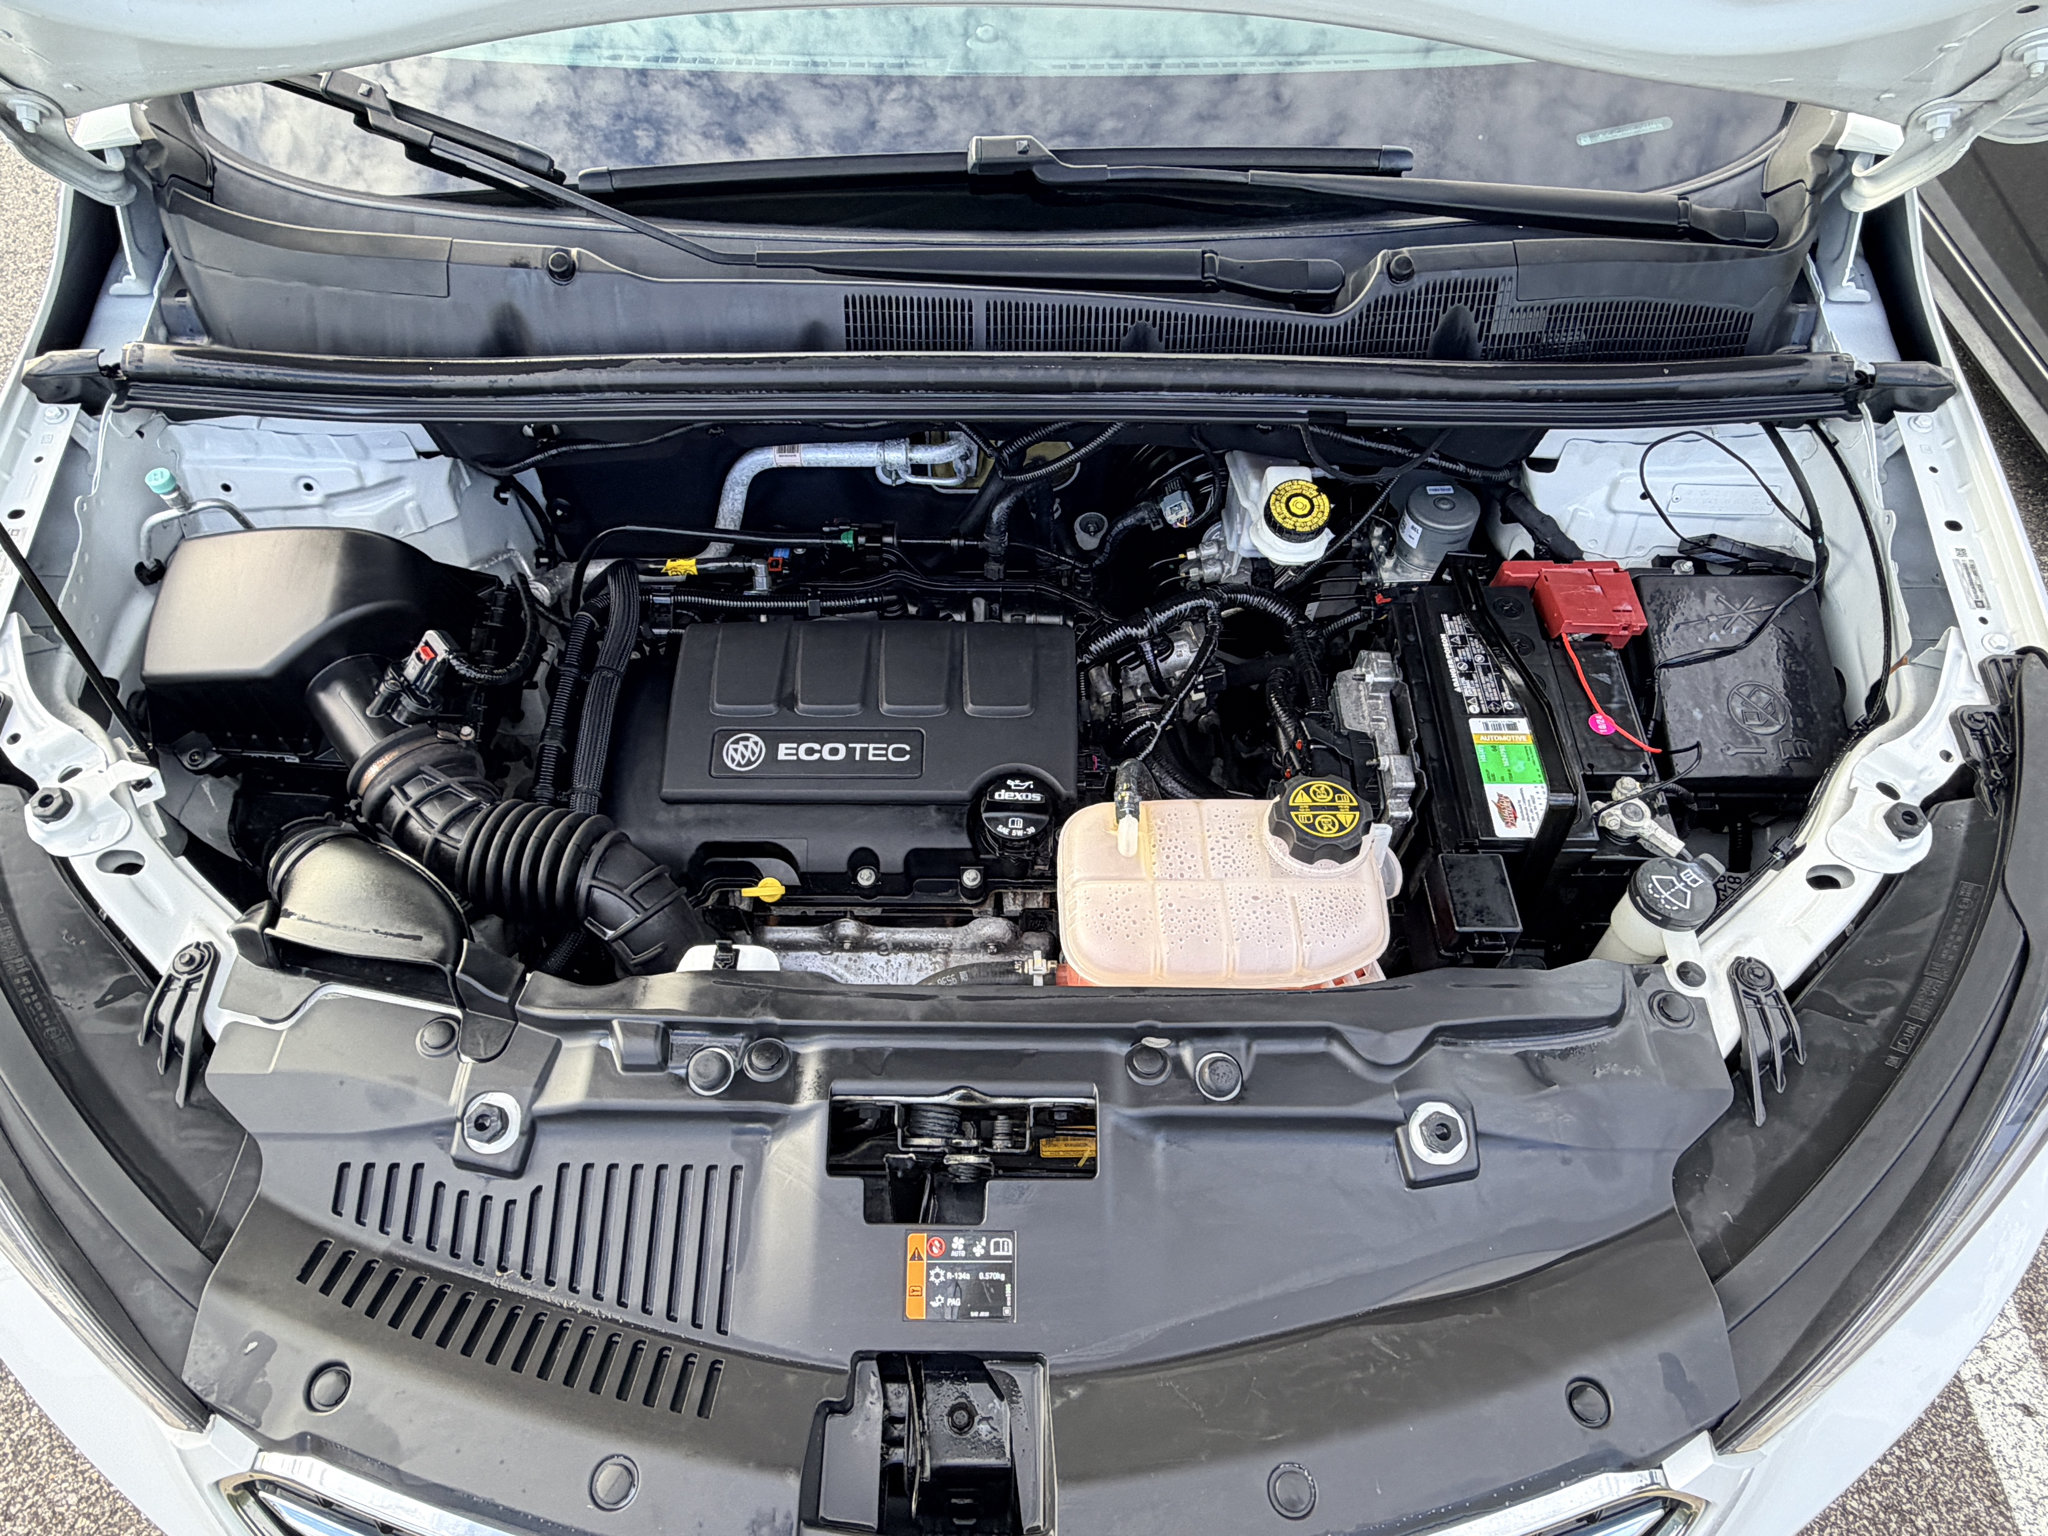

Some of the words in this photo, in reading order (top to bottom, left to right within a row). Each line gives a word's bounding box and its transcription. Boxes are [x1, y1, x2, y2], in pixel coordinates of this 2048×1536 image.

[777, 742, 911, 762] ECOTEC
[994, 789, 1042, 801] dexos
[996, 824, 1011, 836] SAE
[1011, 825, 1036, 837] 5W-30
[946, 1272, 971, 1280] R-134a
[946, 1297, 961, 1307] PAG
